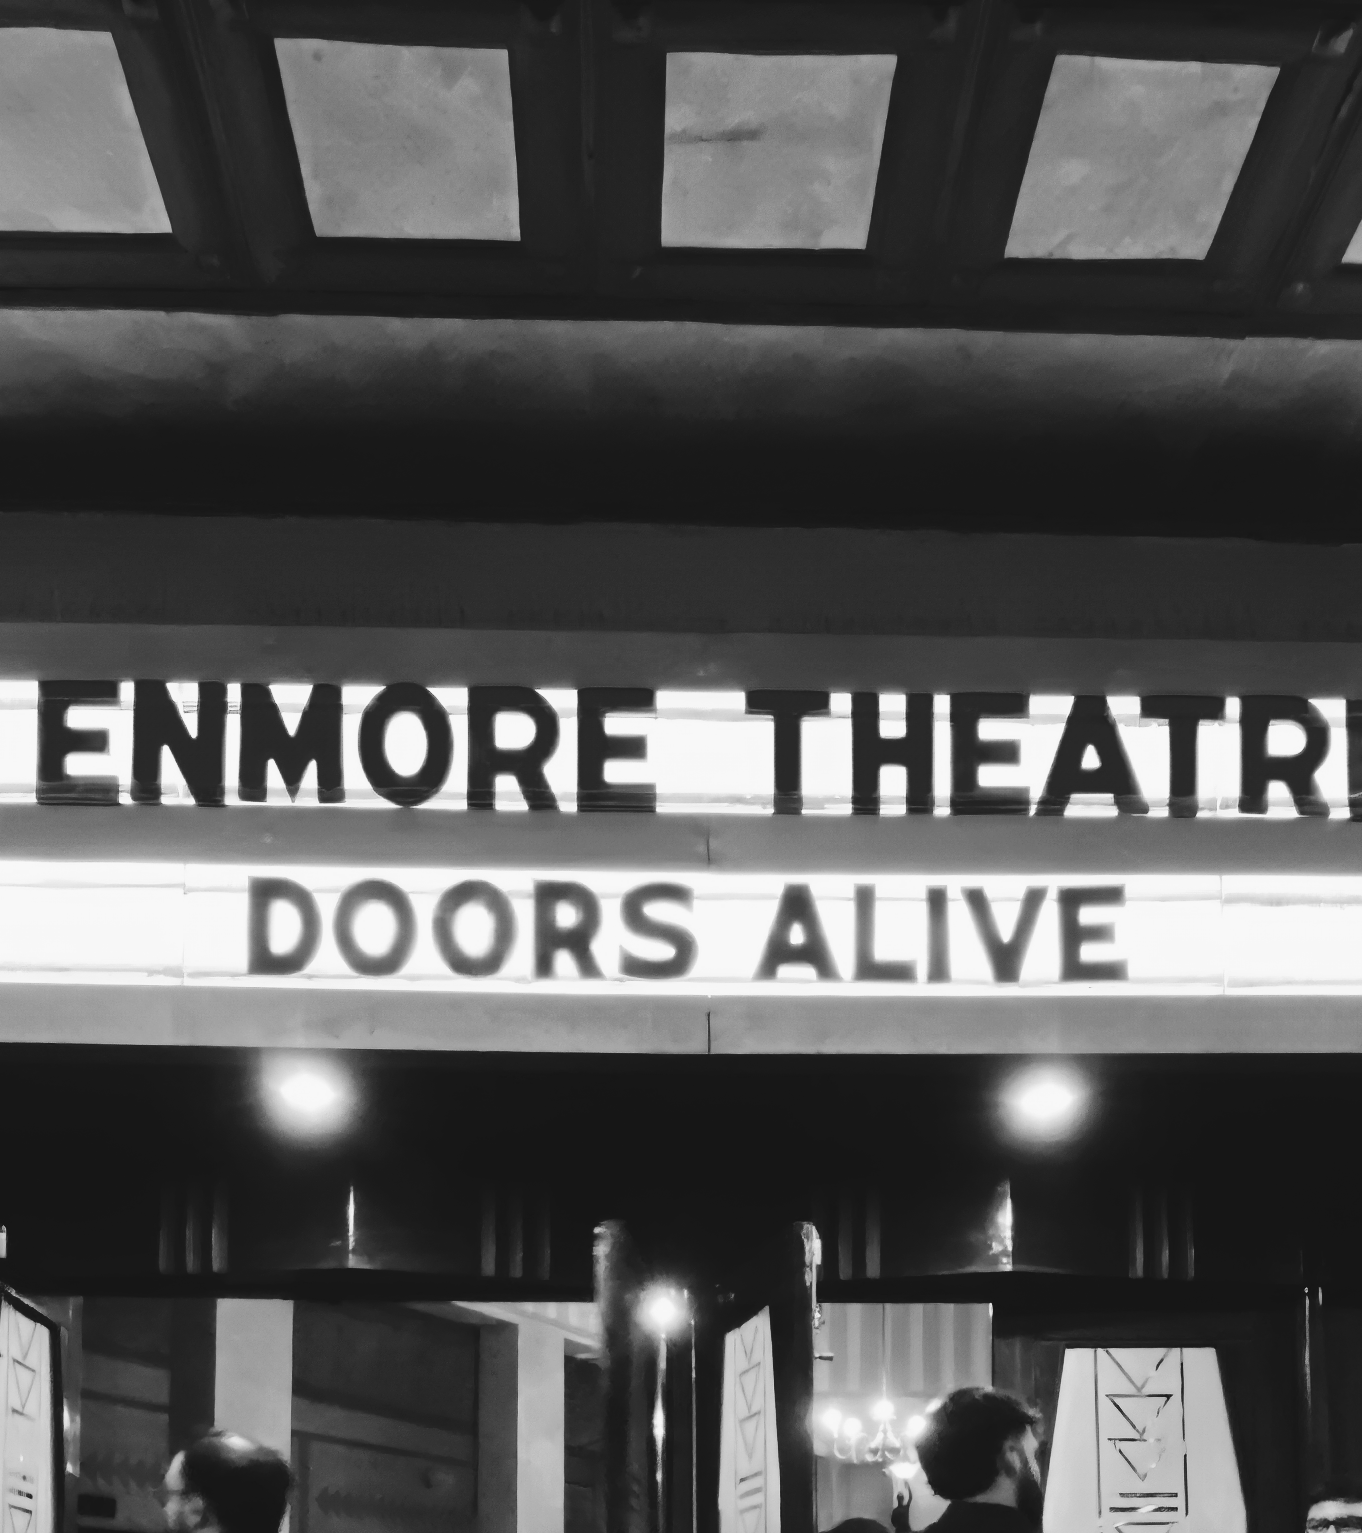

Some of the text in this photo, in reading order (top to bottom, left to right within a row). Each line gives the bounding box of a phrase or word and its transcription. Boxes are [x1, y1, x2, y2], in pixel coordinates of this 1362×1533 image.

[35, 680, 658, 814] ENMORE
[246, 875, 1130, 985] DOORS ALIVE
